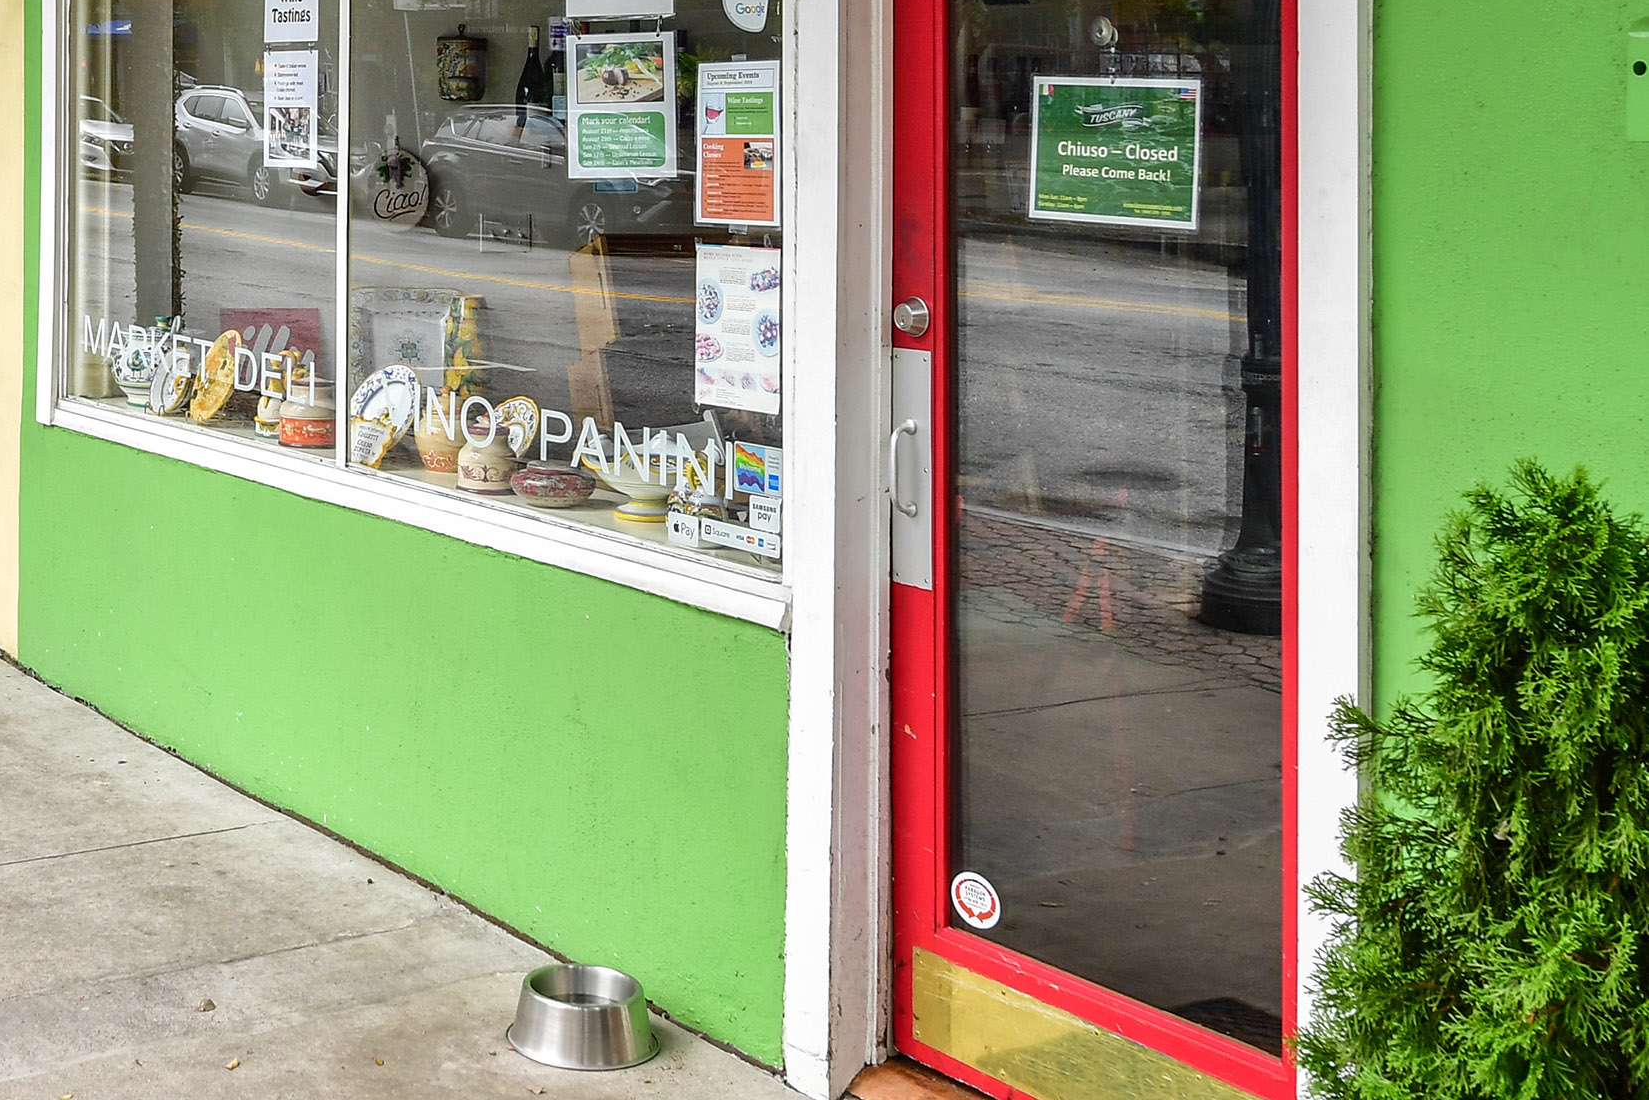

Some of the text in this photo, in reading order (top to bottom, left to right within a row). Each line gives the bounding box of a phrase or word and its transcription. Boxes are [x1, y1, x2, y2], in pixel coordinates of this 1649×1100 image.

[271, 7, 311, 23] Tastings
[706, 71, 760, 81] Upcoming Events
[1089, 107, 1139, 124] TUSCANY
[1057, 140, 1108, 158] Chiuso
[1125, 144, 1178, 161] Closed
[1062, 164, 1171, 182] Please Come Back!
[374, 183, 428, 219] Ciao!
[84, 314, 216, 383] MARKET
[234, 346, 316, 407] DELI
[540, 408, 734, 500] PANINI
[752, 503, 777, 513] SAMSUNG
[757, 511, 772, 523] pay
[680, 522, 695, 540] Pay
[712, 527, 730, 539] Square
